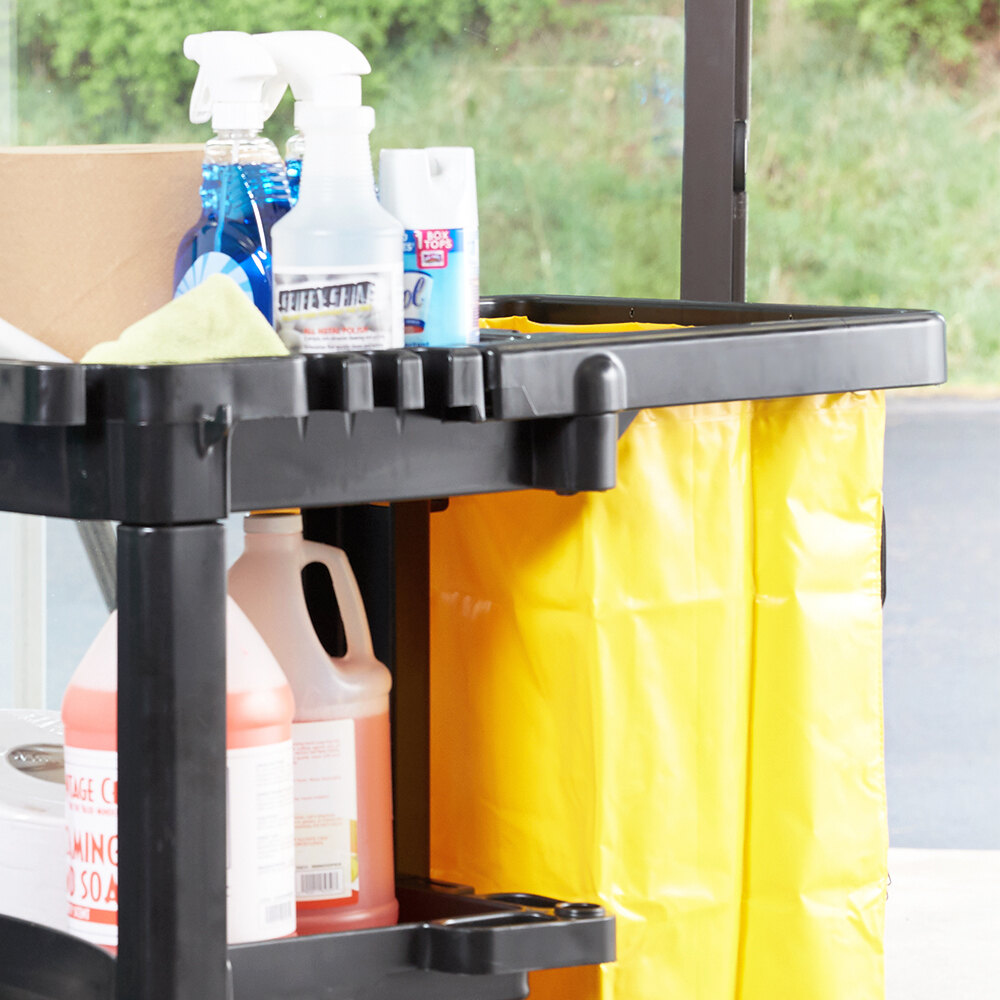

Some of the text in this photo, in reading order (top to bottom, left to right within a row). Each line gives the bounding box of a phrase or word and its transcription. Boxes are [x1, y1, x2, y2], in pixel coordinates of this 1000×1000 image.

[424, 240, 452, 249] TOPS
[426, 231, 449, 240] BOX
[403, 277, 425, 309] ol
[65, 774, 94, 802] TAGE
[80, 870, 118, 903] SOA
